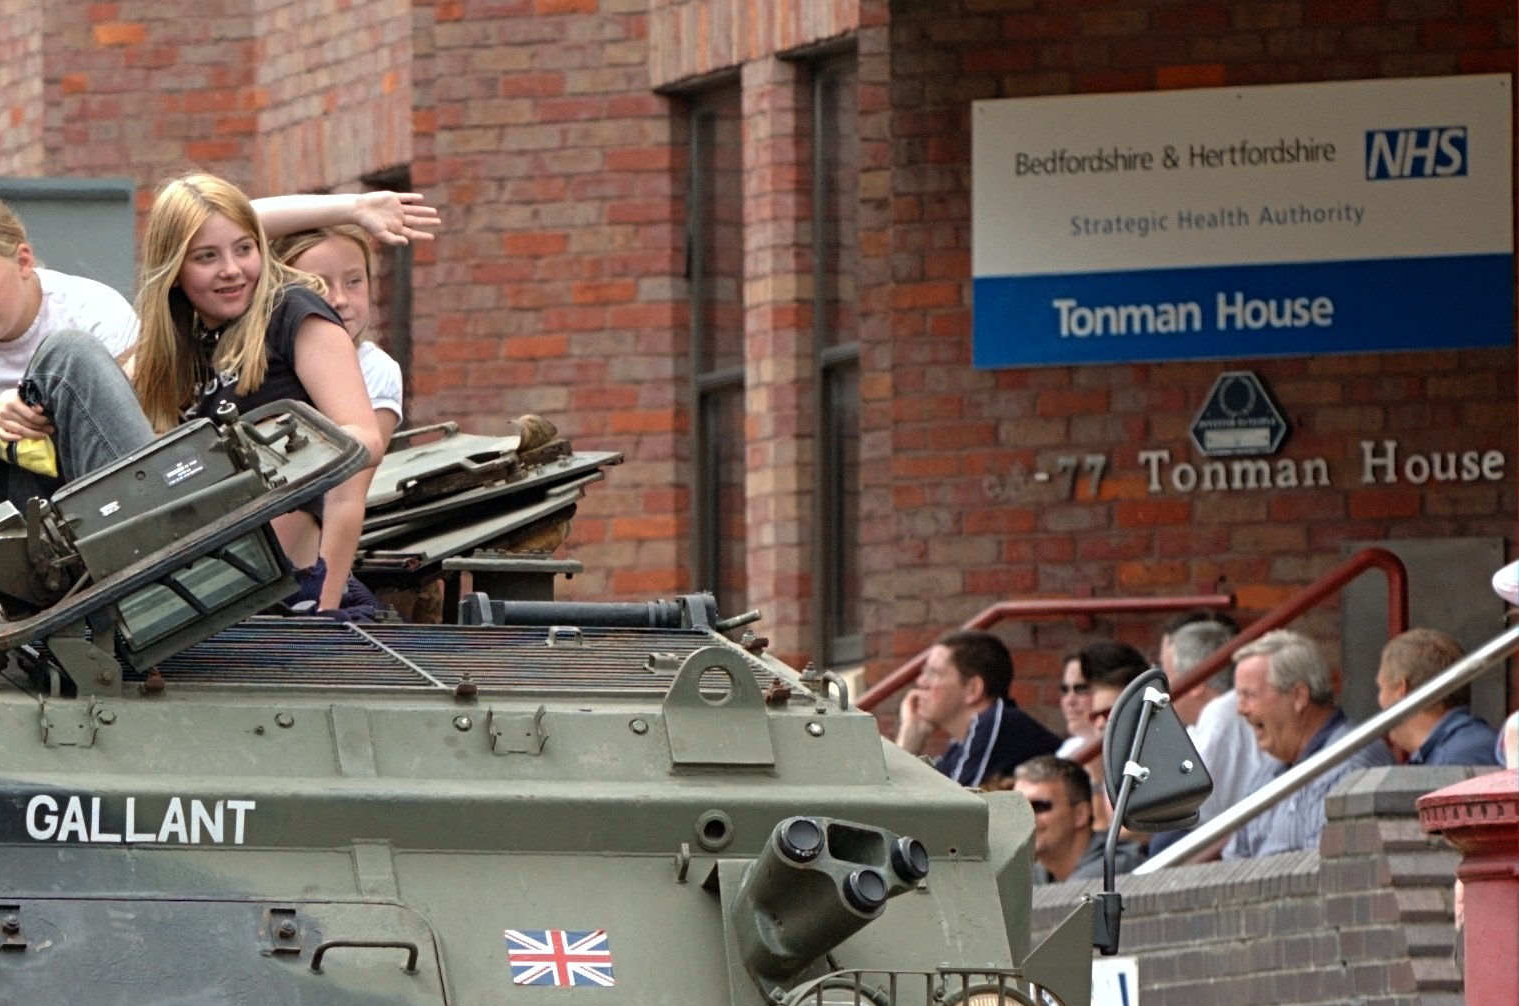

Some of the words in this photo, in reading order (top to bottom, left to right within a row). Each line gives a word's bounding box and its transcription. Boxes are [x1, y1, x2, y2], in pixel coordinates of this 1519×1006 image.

[1015, 146, 1154, 176] Bedfordshire
[1163, 144, 1180, 170] &
[1189, 137, 1337, 168] Hertfordshire
[1368, 127, 1464, 179] NHS
[1070, 212, 1169, 238] Strategic
[1177, 206, 1250, 231] Health
[1259, 202, 1365, 230] Authority
[1053, 298, 1202, 338] Tonman
[1216, 291, 1335, 330] House
[1138, 449, 1331, 493] Tonman
[1360, 440, 1506, 483] House
[25, 794, 256, 845] GALLANT
